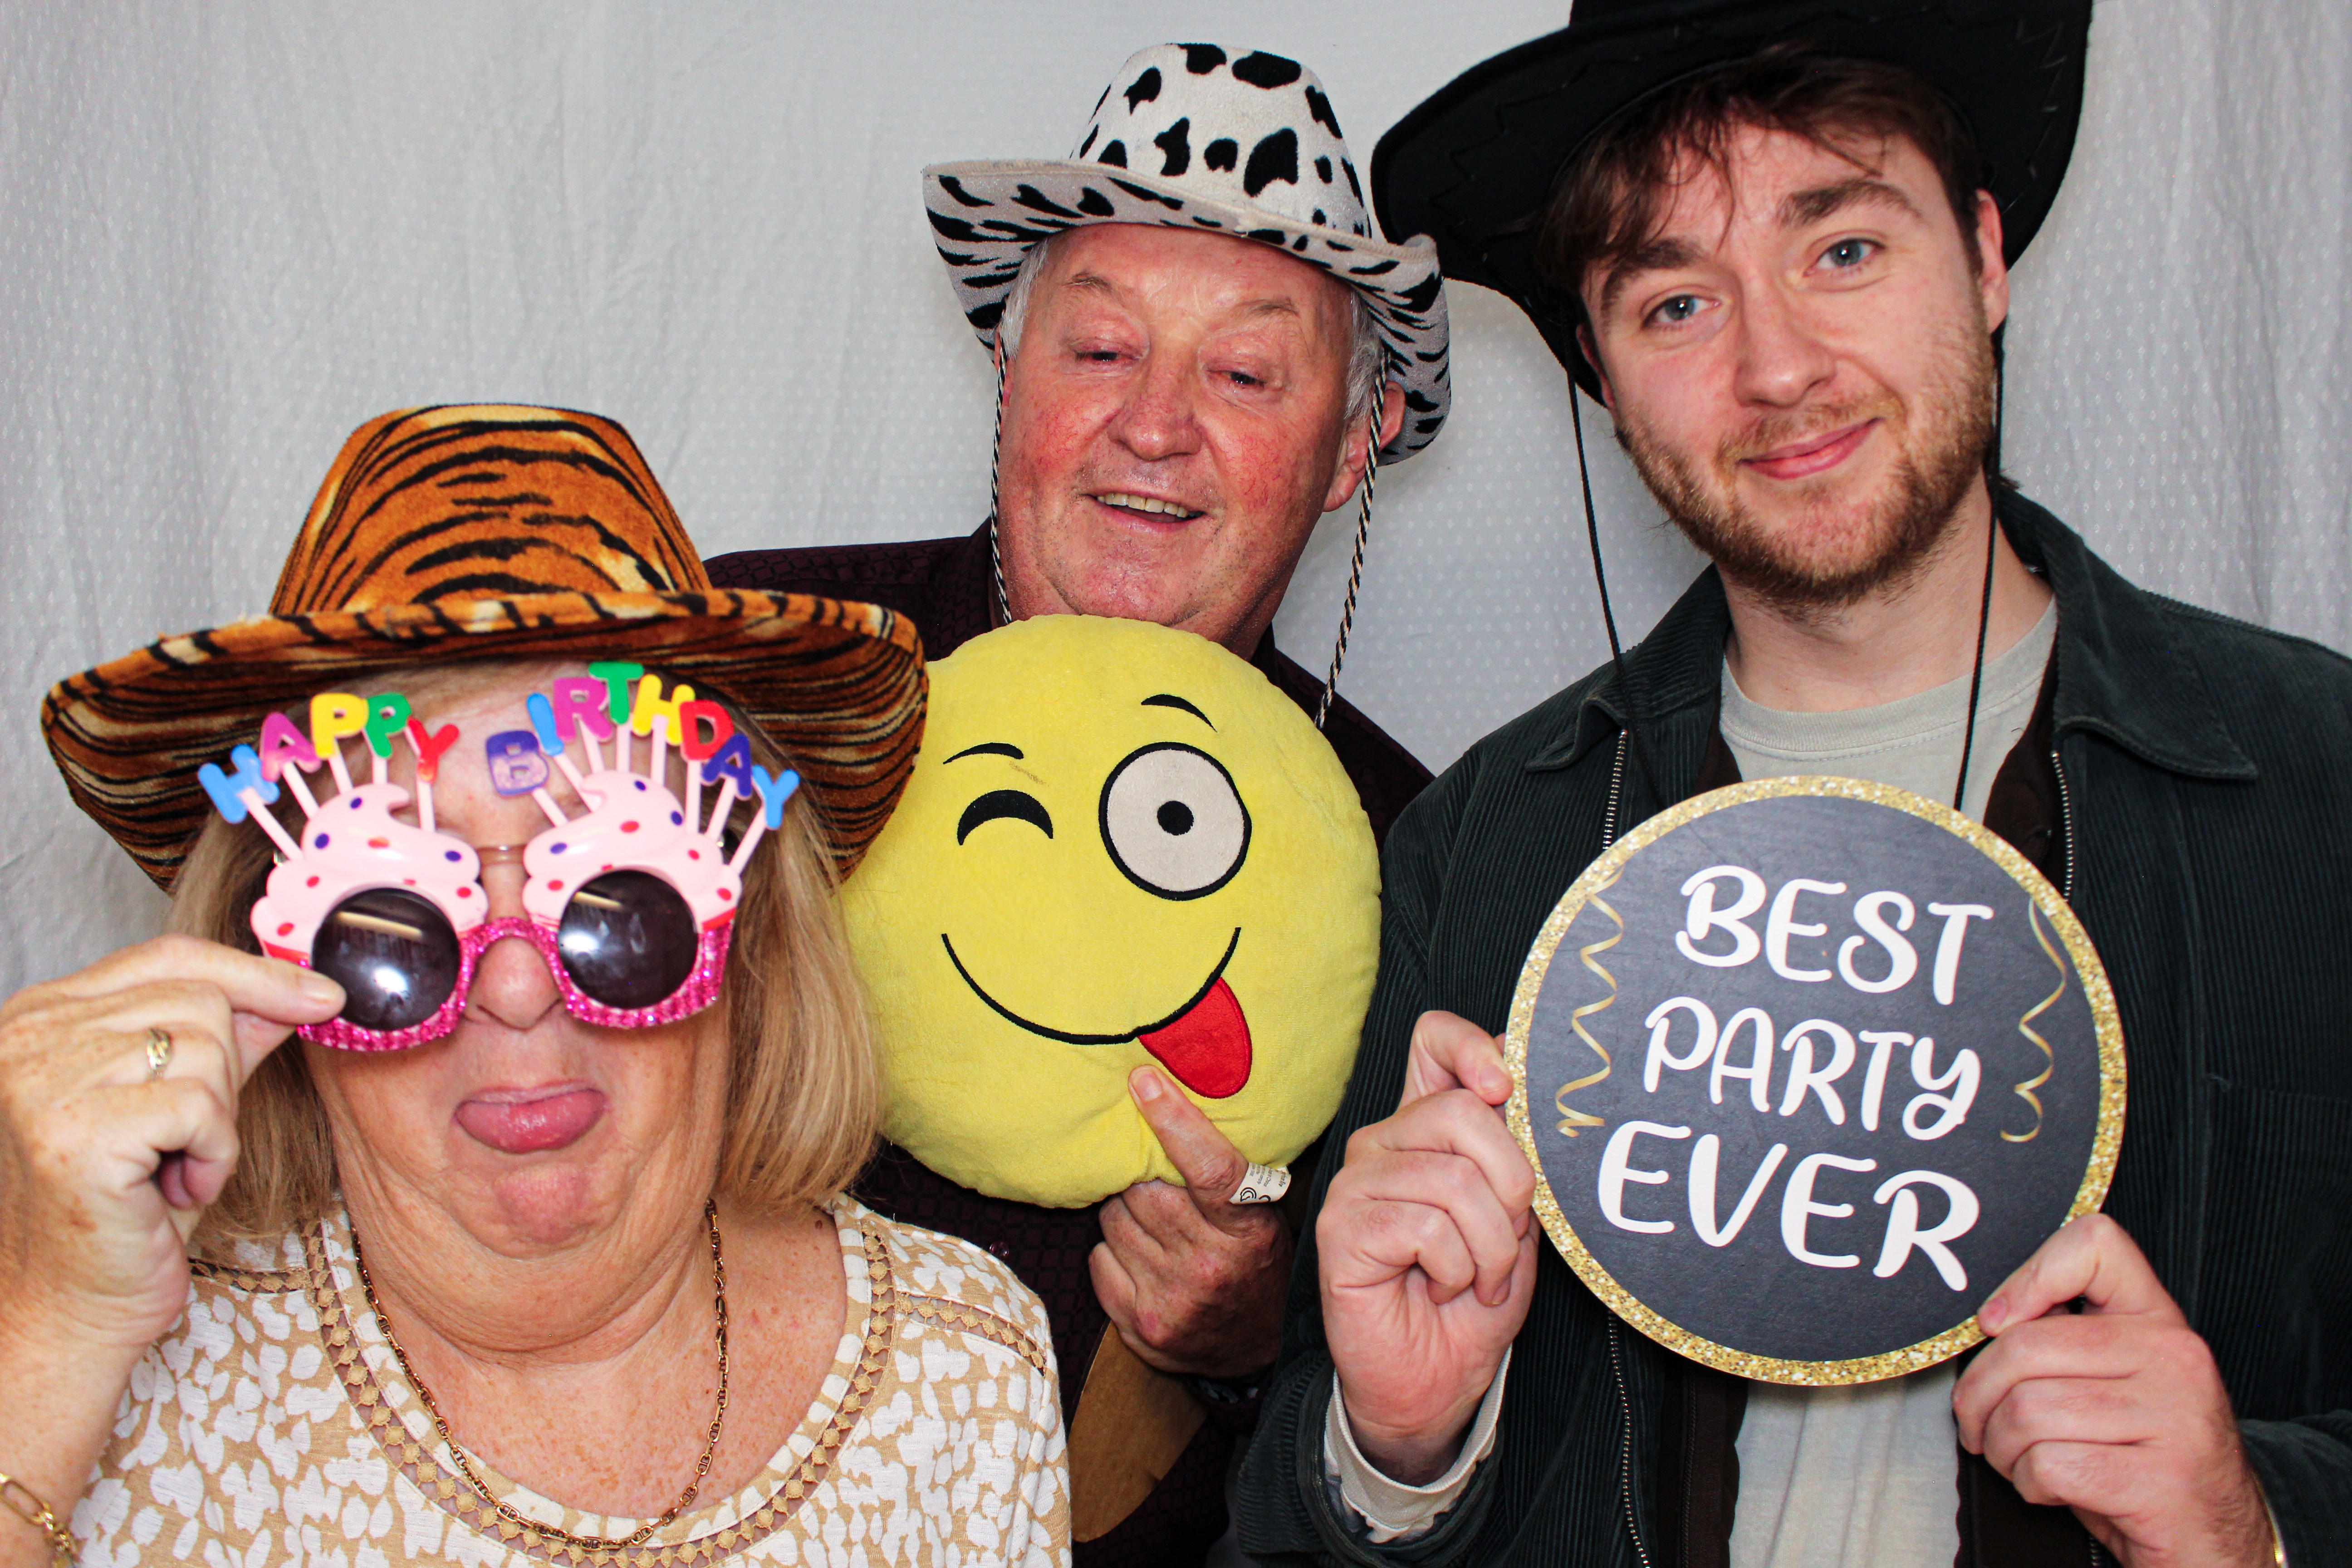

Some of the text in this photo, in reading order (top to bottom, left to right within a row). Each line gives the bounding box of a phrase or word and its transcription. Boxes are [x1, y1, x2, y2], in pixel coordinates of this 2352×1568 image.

[198, 662, 799, 829] HAPPY BIRTHDAY
[1675, 865, 1994, 1005] BEST
[1643, 996, 1981, 1140] PARTY
[1597, 1120, 1980, 1292] EVER
